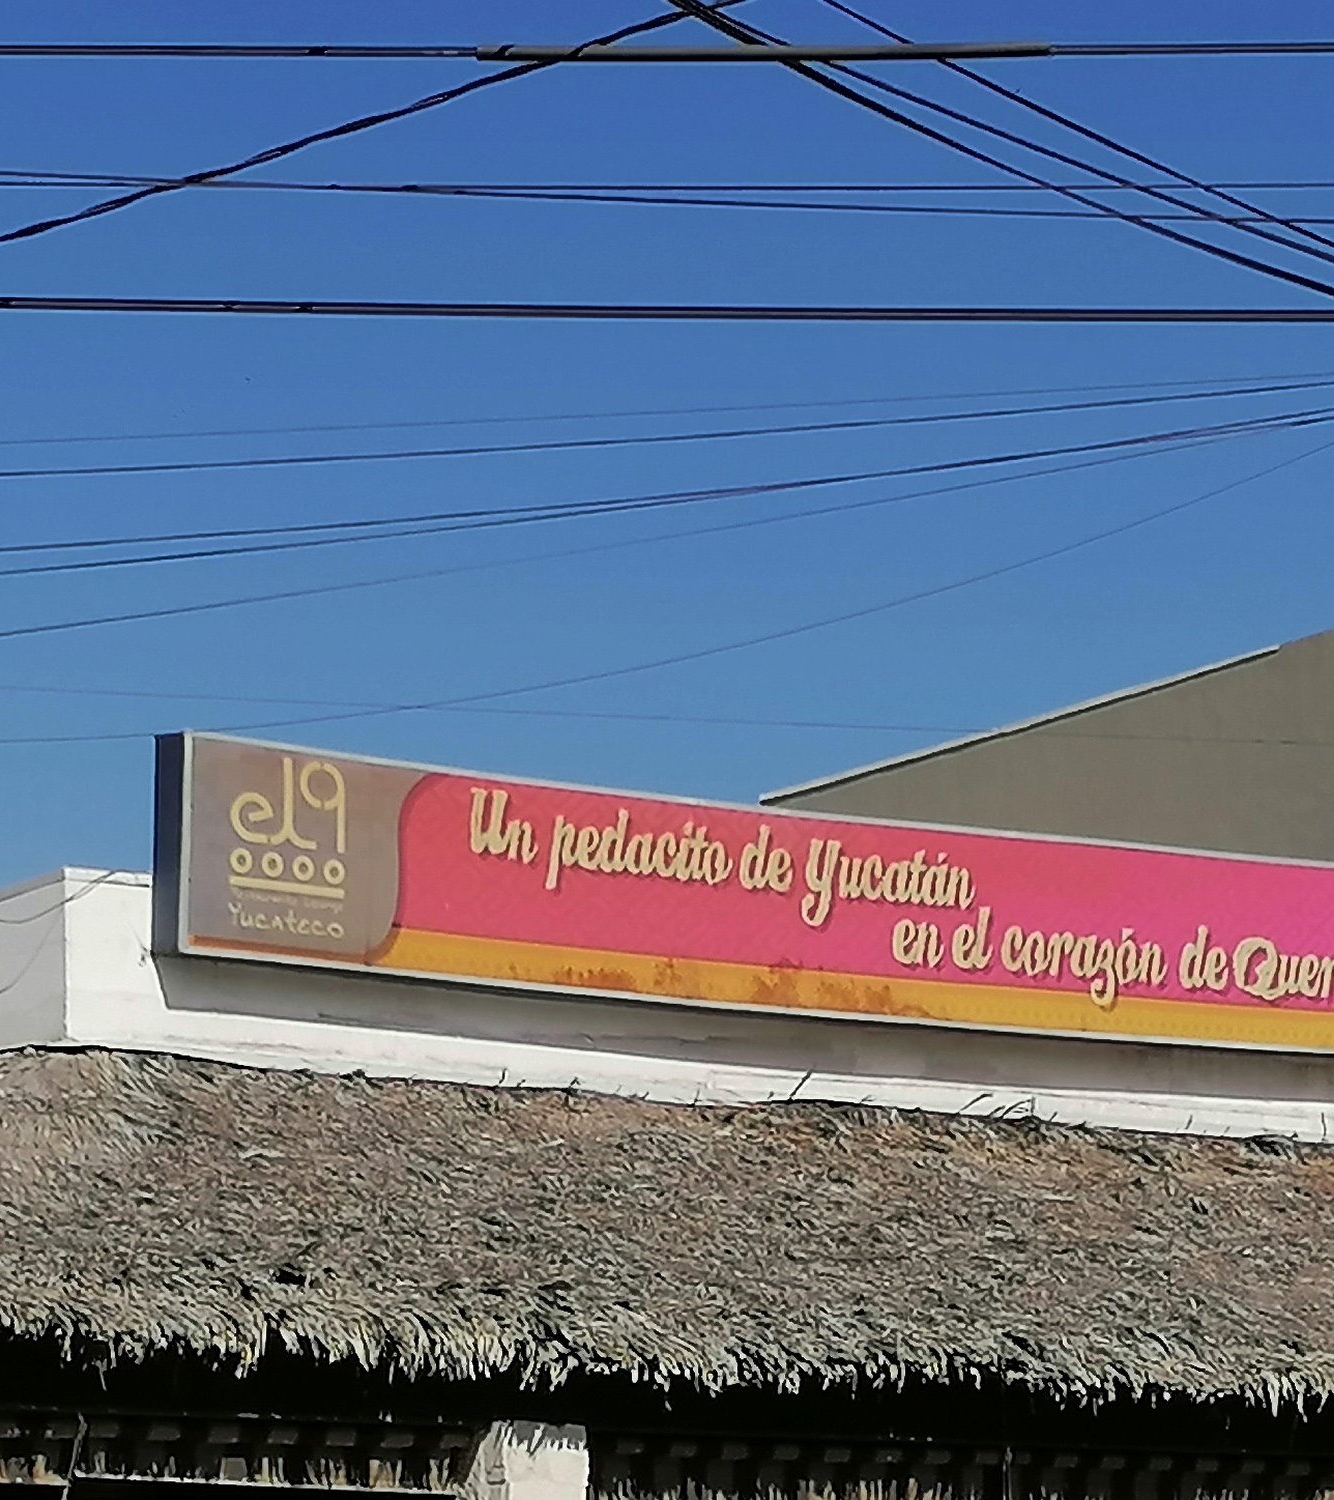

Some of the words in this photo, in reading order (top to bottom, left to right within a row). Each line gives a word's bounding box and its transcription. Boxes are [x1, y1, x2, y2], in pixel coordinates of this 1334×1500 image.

[469, 787, 538, 864] Un
[545, 808, 733, 890] pedacito
[739, 823, 793, 893] de
[801, 838, 977, 927] Yucatán
[892, 918, 945, 968] en
[952, 906, 993, 969] el
[1001, 926, 1168, 1007] corazón
[1179, 925, 1229, 991] de
